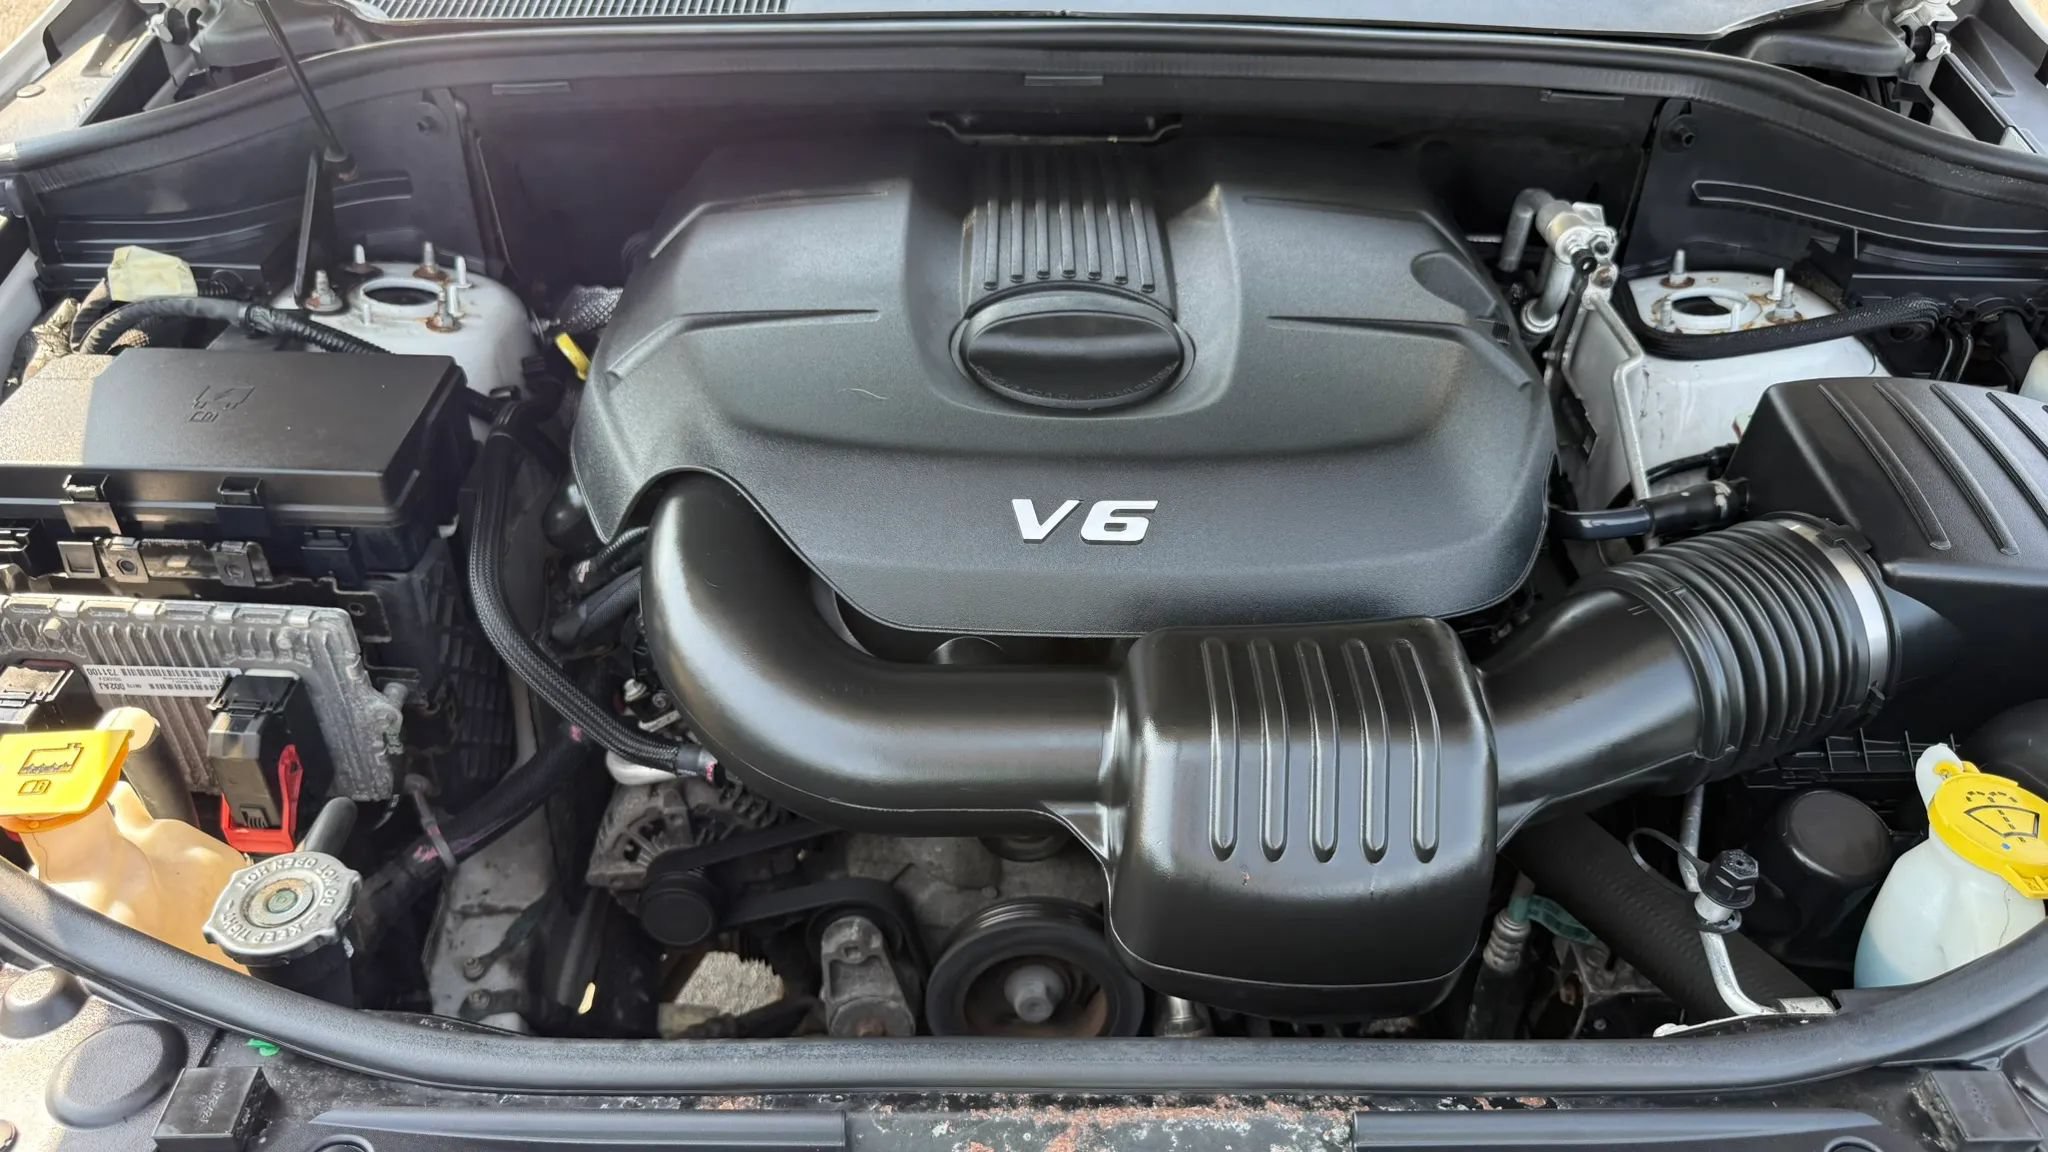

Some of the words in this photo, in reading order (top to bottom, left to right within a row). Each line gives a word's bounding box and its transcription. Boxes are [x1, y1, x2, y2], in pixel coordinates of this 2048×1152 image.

[1012, 499, 1159, 545] V6
[273, 857, 318, 870] OPEN
[238, 866, 269, 889] HOT
[316, 864, 340, 885] NOT
[251, 925, 303, 944] KEEP
